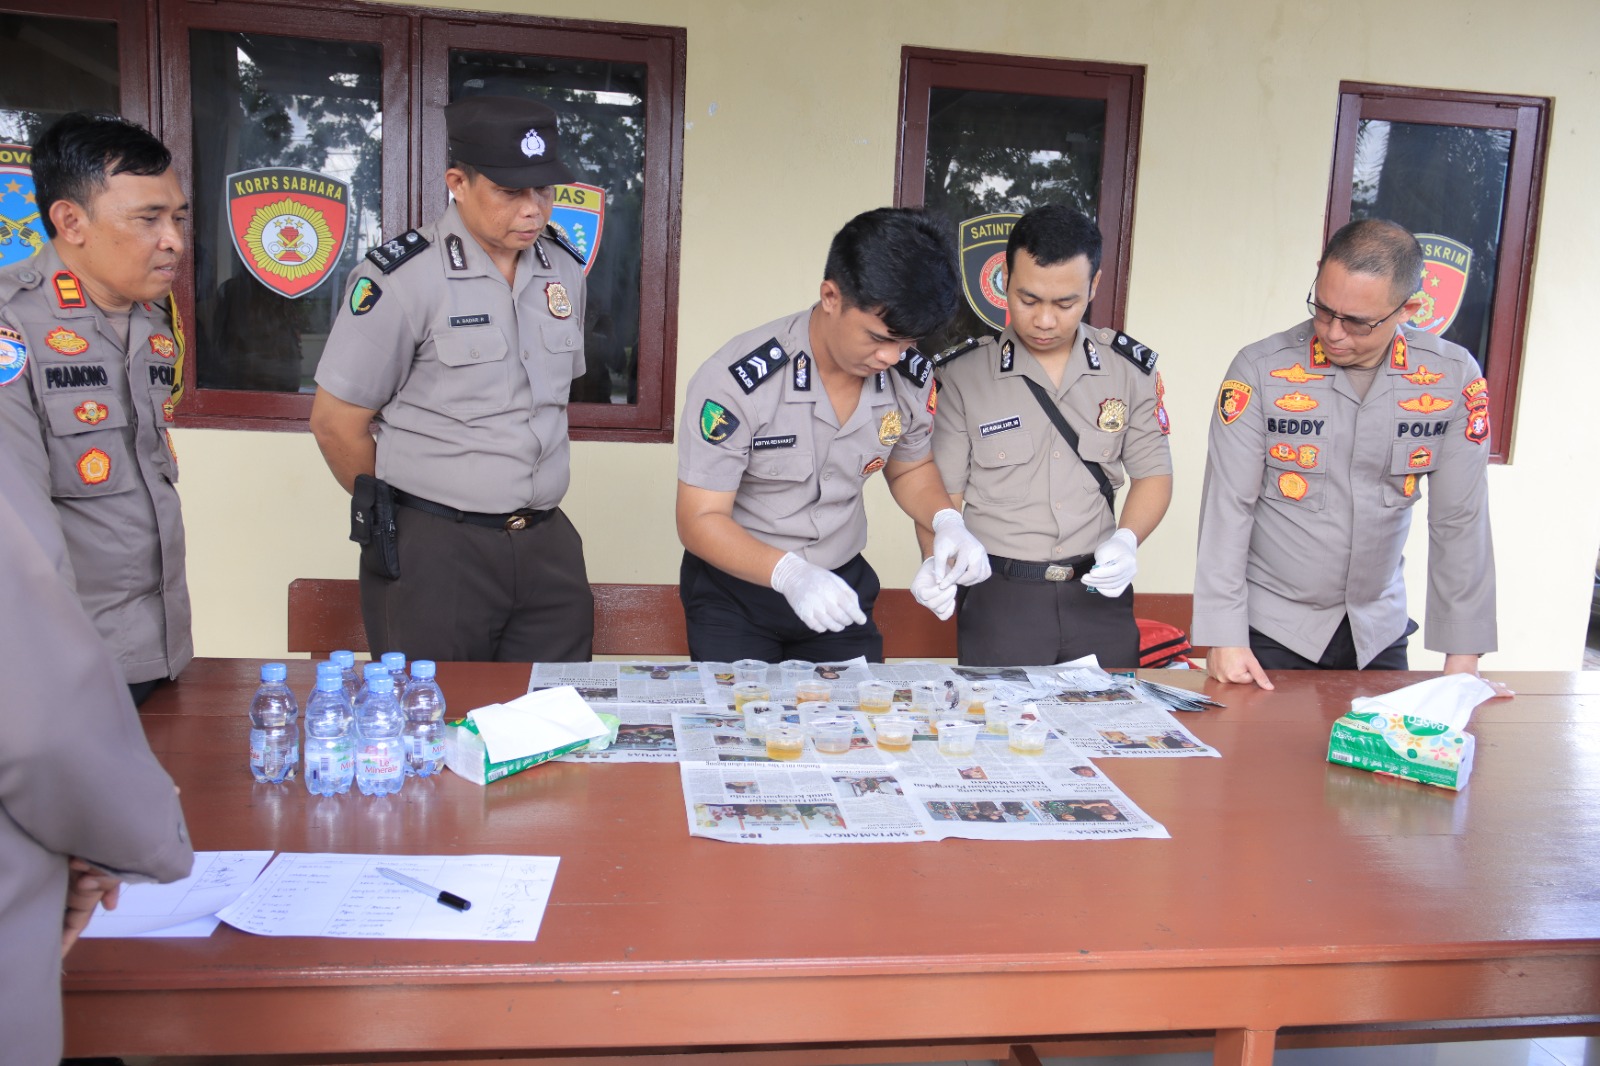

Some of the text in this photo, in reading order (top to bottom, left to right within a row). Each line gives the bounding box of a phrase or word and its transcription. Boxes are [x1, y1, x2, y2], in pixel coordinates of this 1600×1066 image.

[235, 175, 342, 200] KORPS SABHARA
[554, 187, 585, 205] AS
[1420, 244, 1466, 266] SKRIM
[45, 366, 108, 389] PRAMONO
[735, 366, 754, 389] POLISI
[920, 360, 933, 383] POLISI
[1268, 418, 1324, 436] BEDDY
[1397, 420, 1449, 438] POLRI
[1406, 716, 1445, 731] PASEO
[364, 765, 398, 775] Minerale
[379, 759, 390, 768] Le
